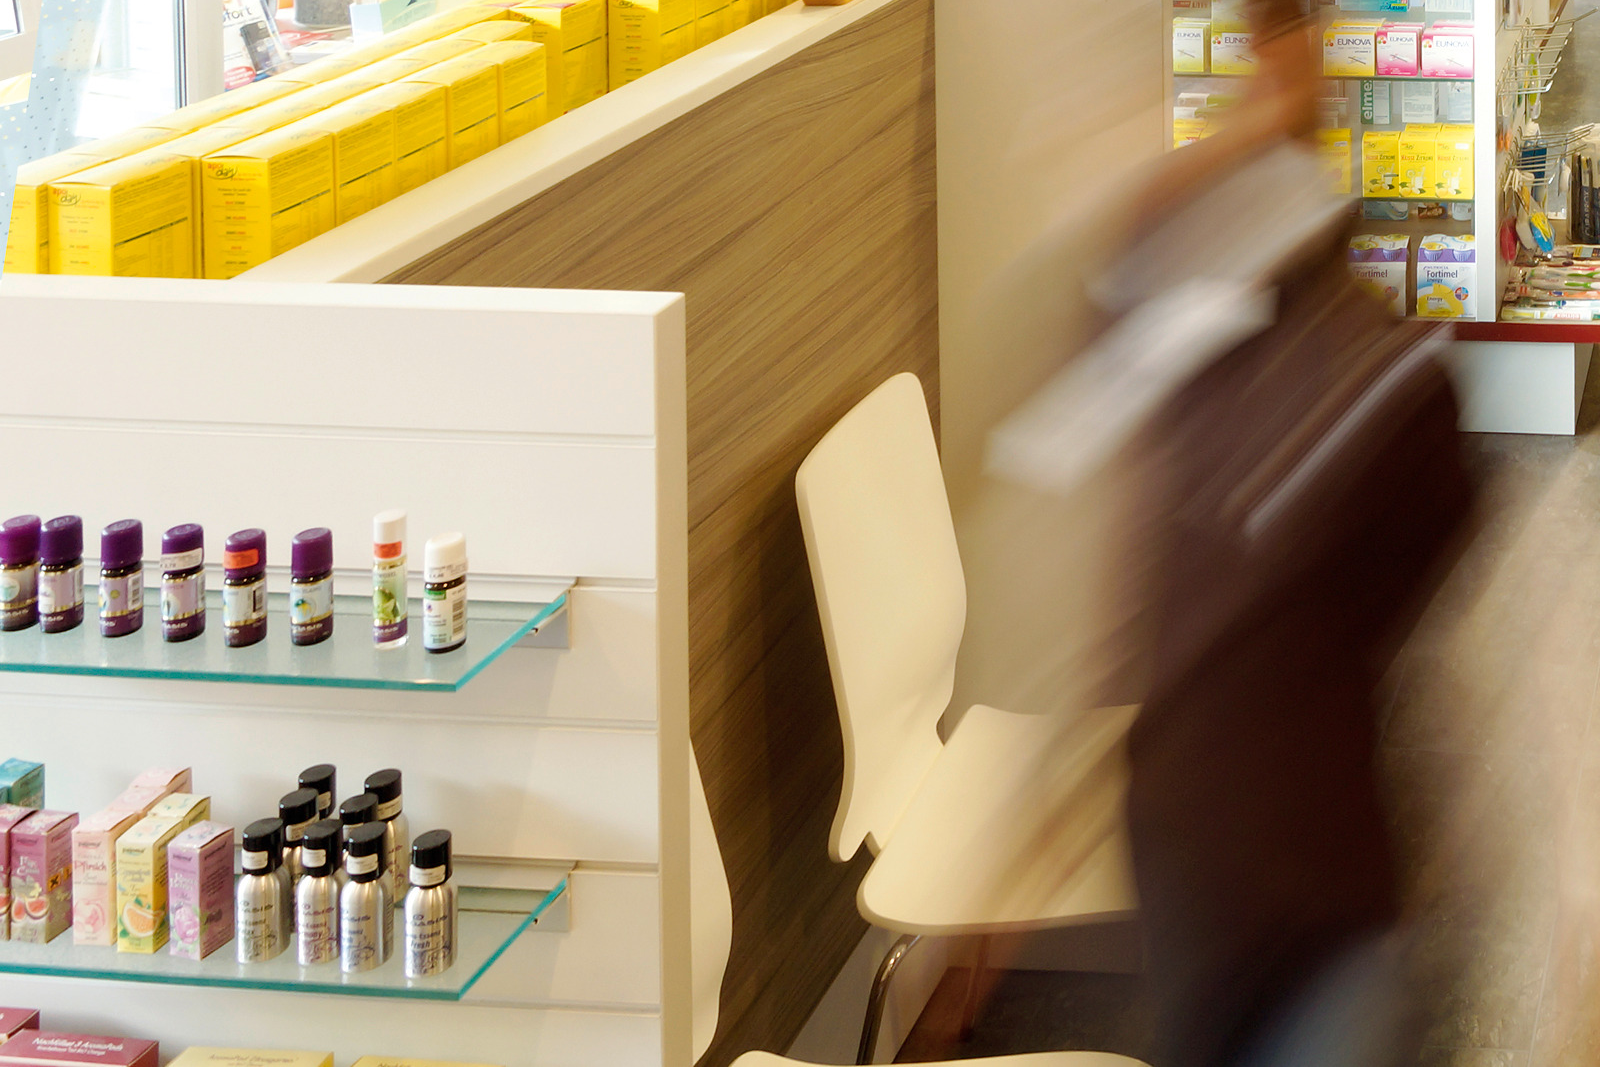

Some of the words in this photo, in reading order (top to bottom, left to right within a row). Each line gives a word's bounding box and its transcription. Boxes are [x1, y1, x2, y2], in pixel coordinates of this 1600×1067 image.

[1224, 36, 1251, 44] EUNOV
[1337, 38, 1371, 46] EUNOVA
[1356, 269, 1388, 278] Fortimel
[1426, 270, 1458, 278] Fortimel
